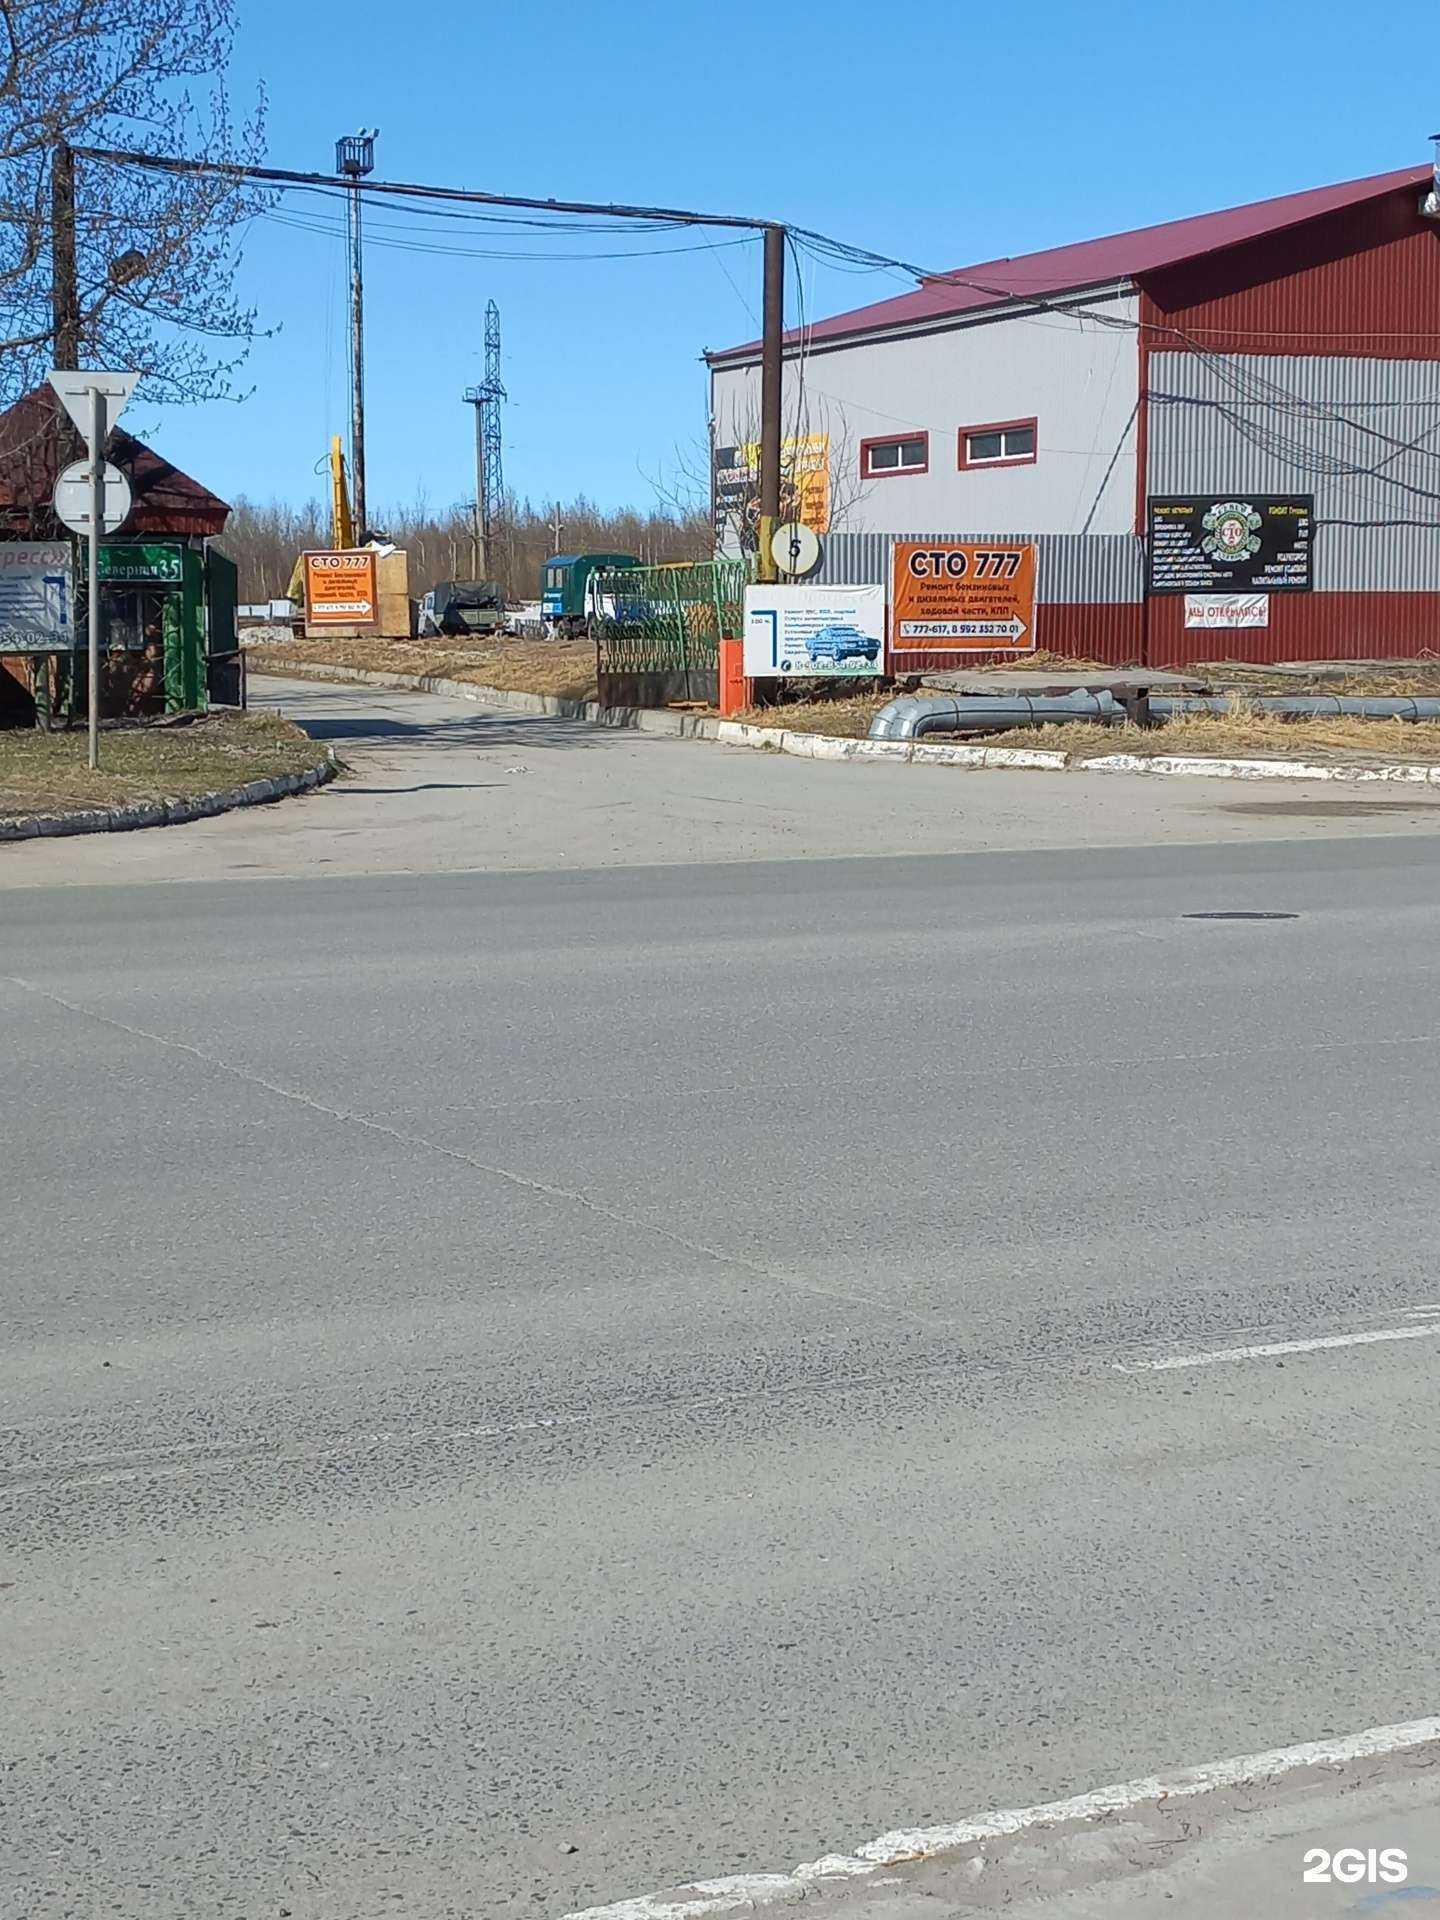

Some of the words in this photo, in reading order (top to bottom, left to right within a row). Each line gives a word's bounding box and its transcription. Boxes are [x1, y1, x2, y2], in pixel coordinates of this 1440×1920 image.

[311, 557, 340, 568] СТО
[344, 557, 368, 567] 777
[909, 551, 967, 577] СТО
[974, 551, 1021, 577] 777
[160, 559, 180, 579] 35
[920, 583, 953, 591] Ремонт
[955, 582, 1009, 591] бензиновых
[916, 594, 965, 604] дизельных
[920, 607, 959, 616] ходовой
[961, 607, 988, 617] части,
[912, 624, 950, 635] 777-617,
[951, 625, 958, 633] 8
[959, 624, 977, 634] 992
